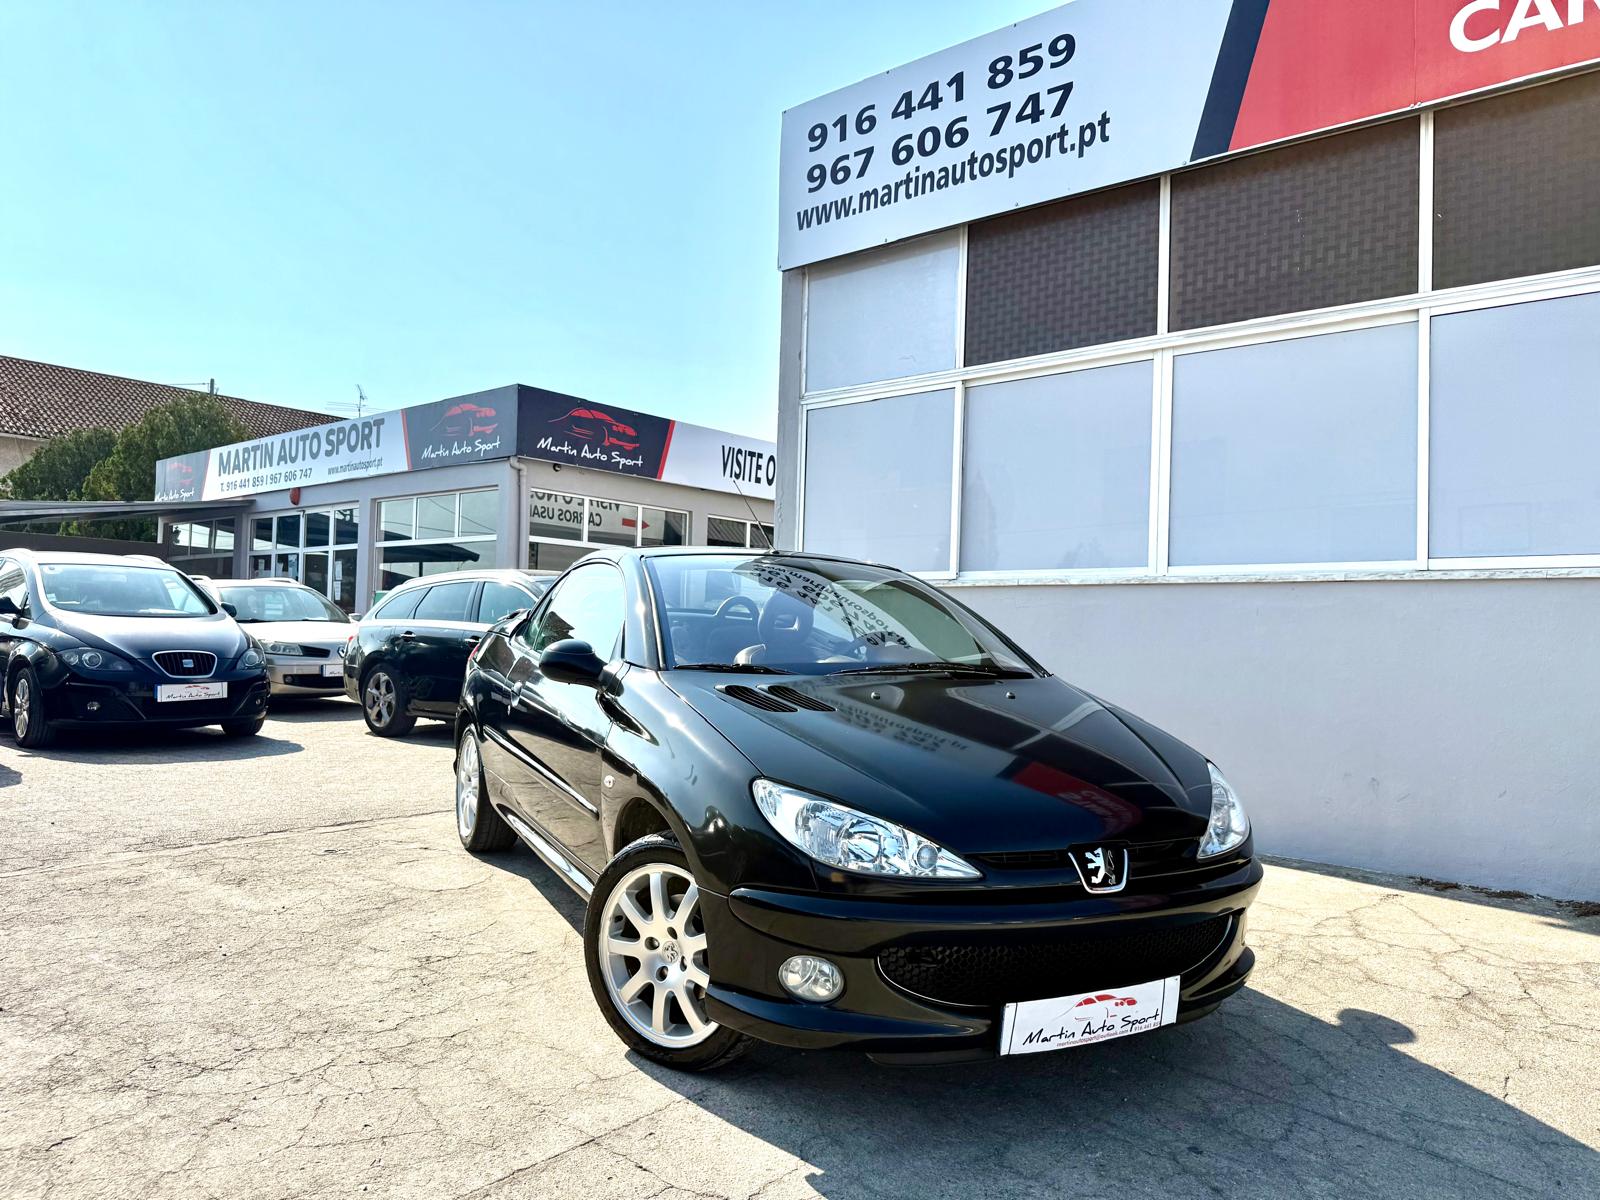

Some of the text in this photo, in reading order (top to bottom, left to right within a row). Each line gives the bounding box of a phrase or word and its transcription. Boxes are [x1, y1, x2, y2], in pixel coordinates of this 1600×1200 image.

[808, 33, 1076, 152] 916 441 859
[807, 81, 1075, 193] 967 606 747
[796, 111, 1111, 231] www.martinautosport.pt
[218, 418, 385, 477] MARTIN AUTO SPORT
[421, 435, 500, 460] Martin Auto Sport
[537, 437, 643, 469] Martin Auto Sport
[722, 445, 763, 484] VISITE
[226, 480, 237, 491] 916
[239, 478, 250, 489] 441
[252, 475, 264, 487] 859
[270, 472, 282, 485] 967
[284, 470, 297, 482] 606
[300, 468, 312, 479] 747
[1022, 1008, 1160, 1046] Martin Auto Sport
